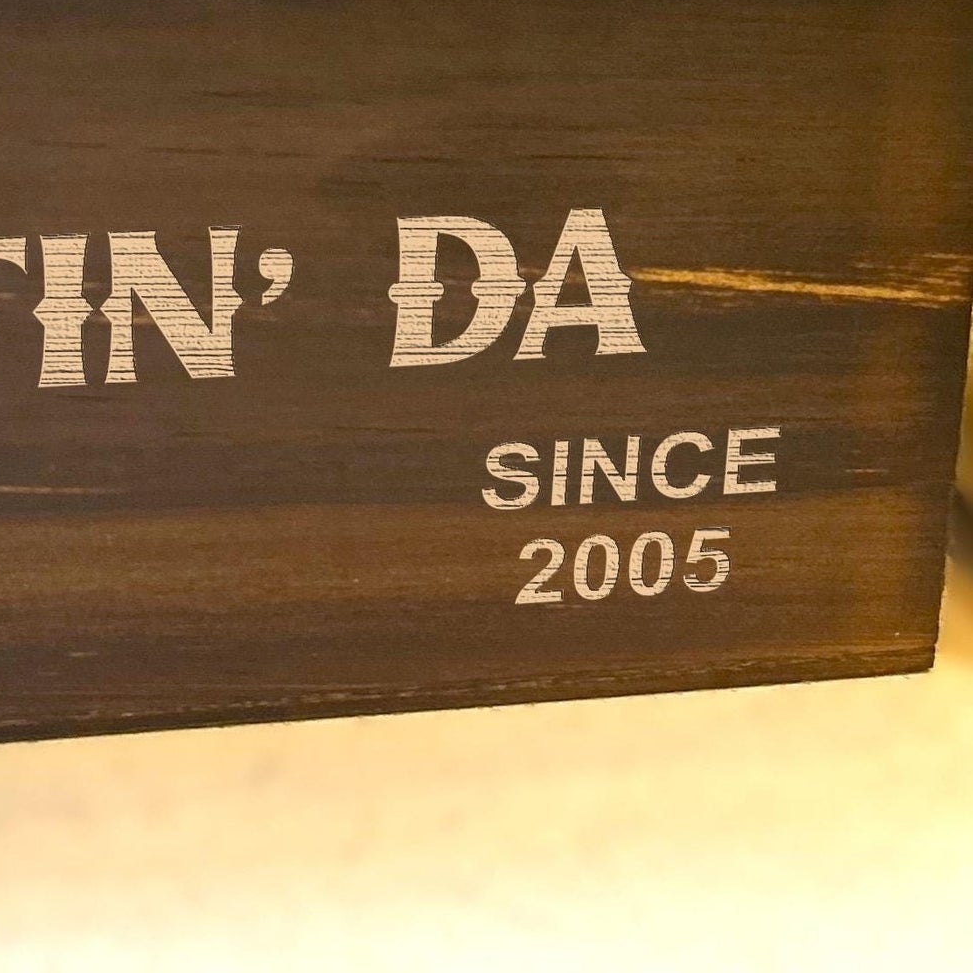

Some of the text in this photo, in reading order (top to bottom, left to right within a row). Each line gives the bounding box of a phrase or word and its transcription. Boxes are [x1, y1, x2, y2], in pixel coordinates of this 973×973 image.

[388, 207, 647, 368] DA
[481, 427, 782, 510] SINCE
[514, 528, 731, 605] 2005
